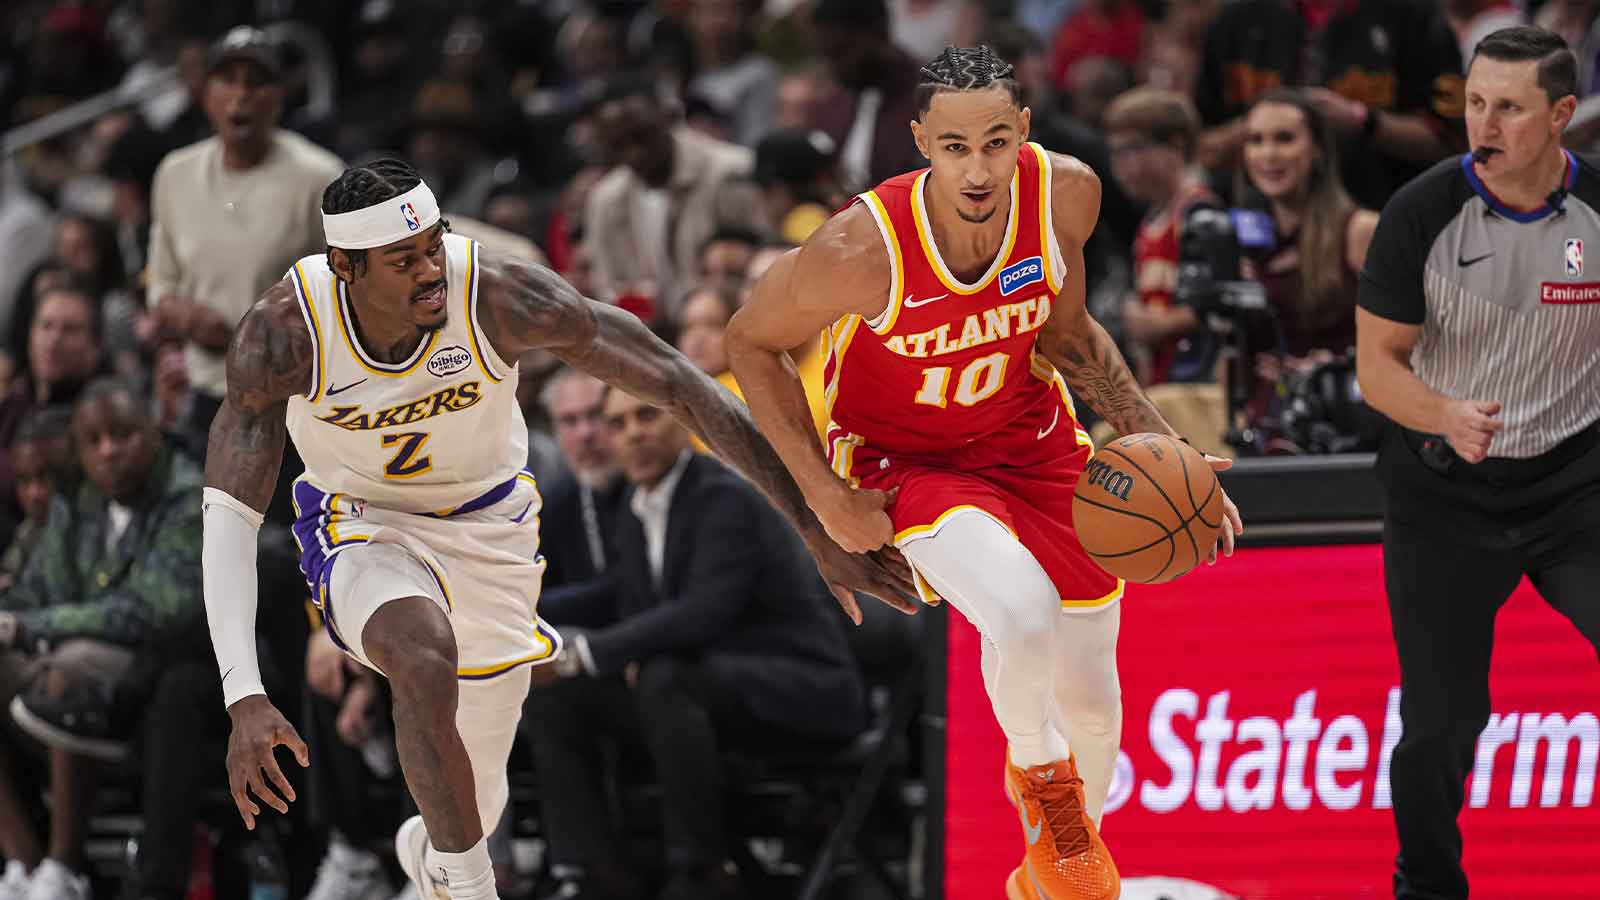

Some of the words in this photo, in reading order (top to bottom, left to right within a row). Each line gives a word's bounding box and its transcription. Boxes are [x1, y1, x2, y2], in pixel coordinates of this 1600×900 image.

[1003, 264, 1038, 288] paze
[882, 295, 1051, 358] ATLANTA
[430, 353, 469, 369] bibigo
[914, 352, 1010, 408] 10
[312, 381, 482, 431] LAKERS
[381, 431, 433, 480] 2
[1140, 687, 1369, 813] State
[1371, 686, 1600, 809] rm
